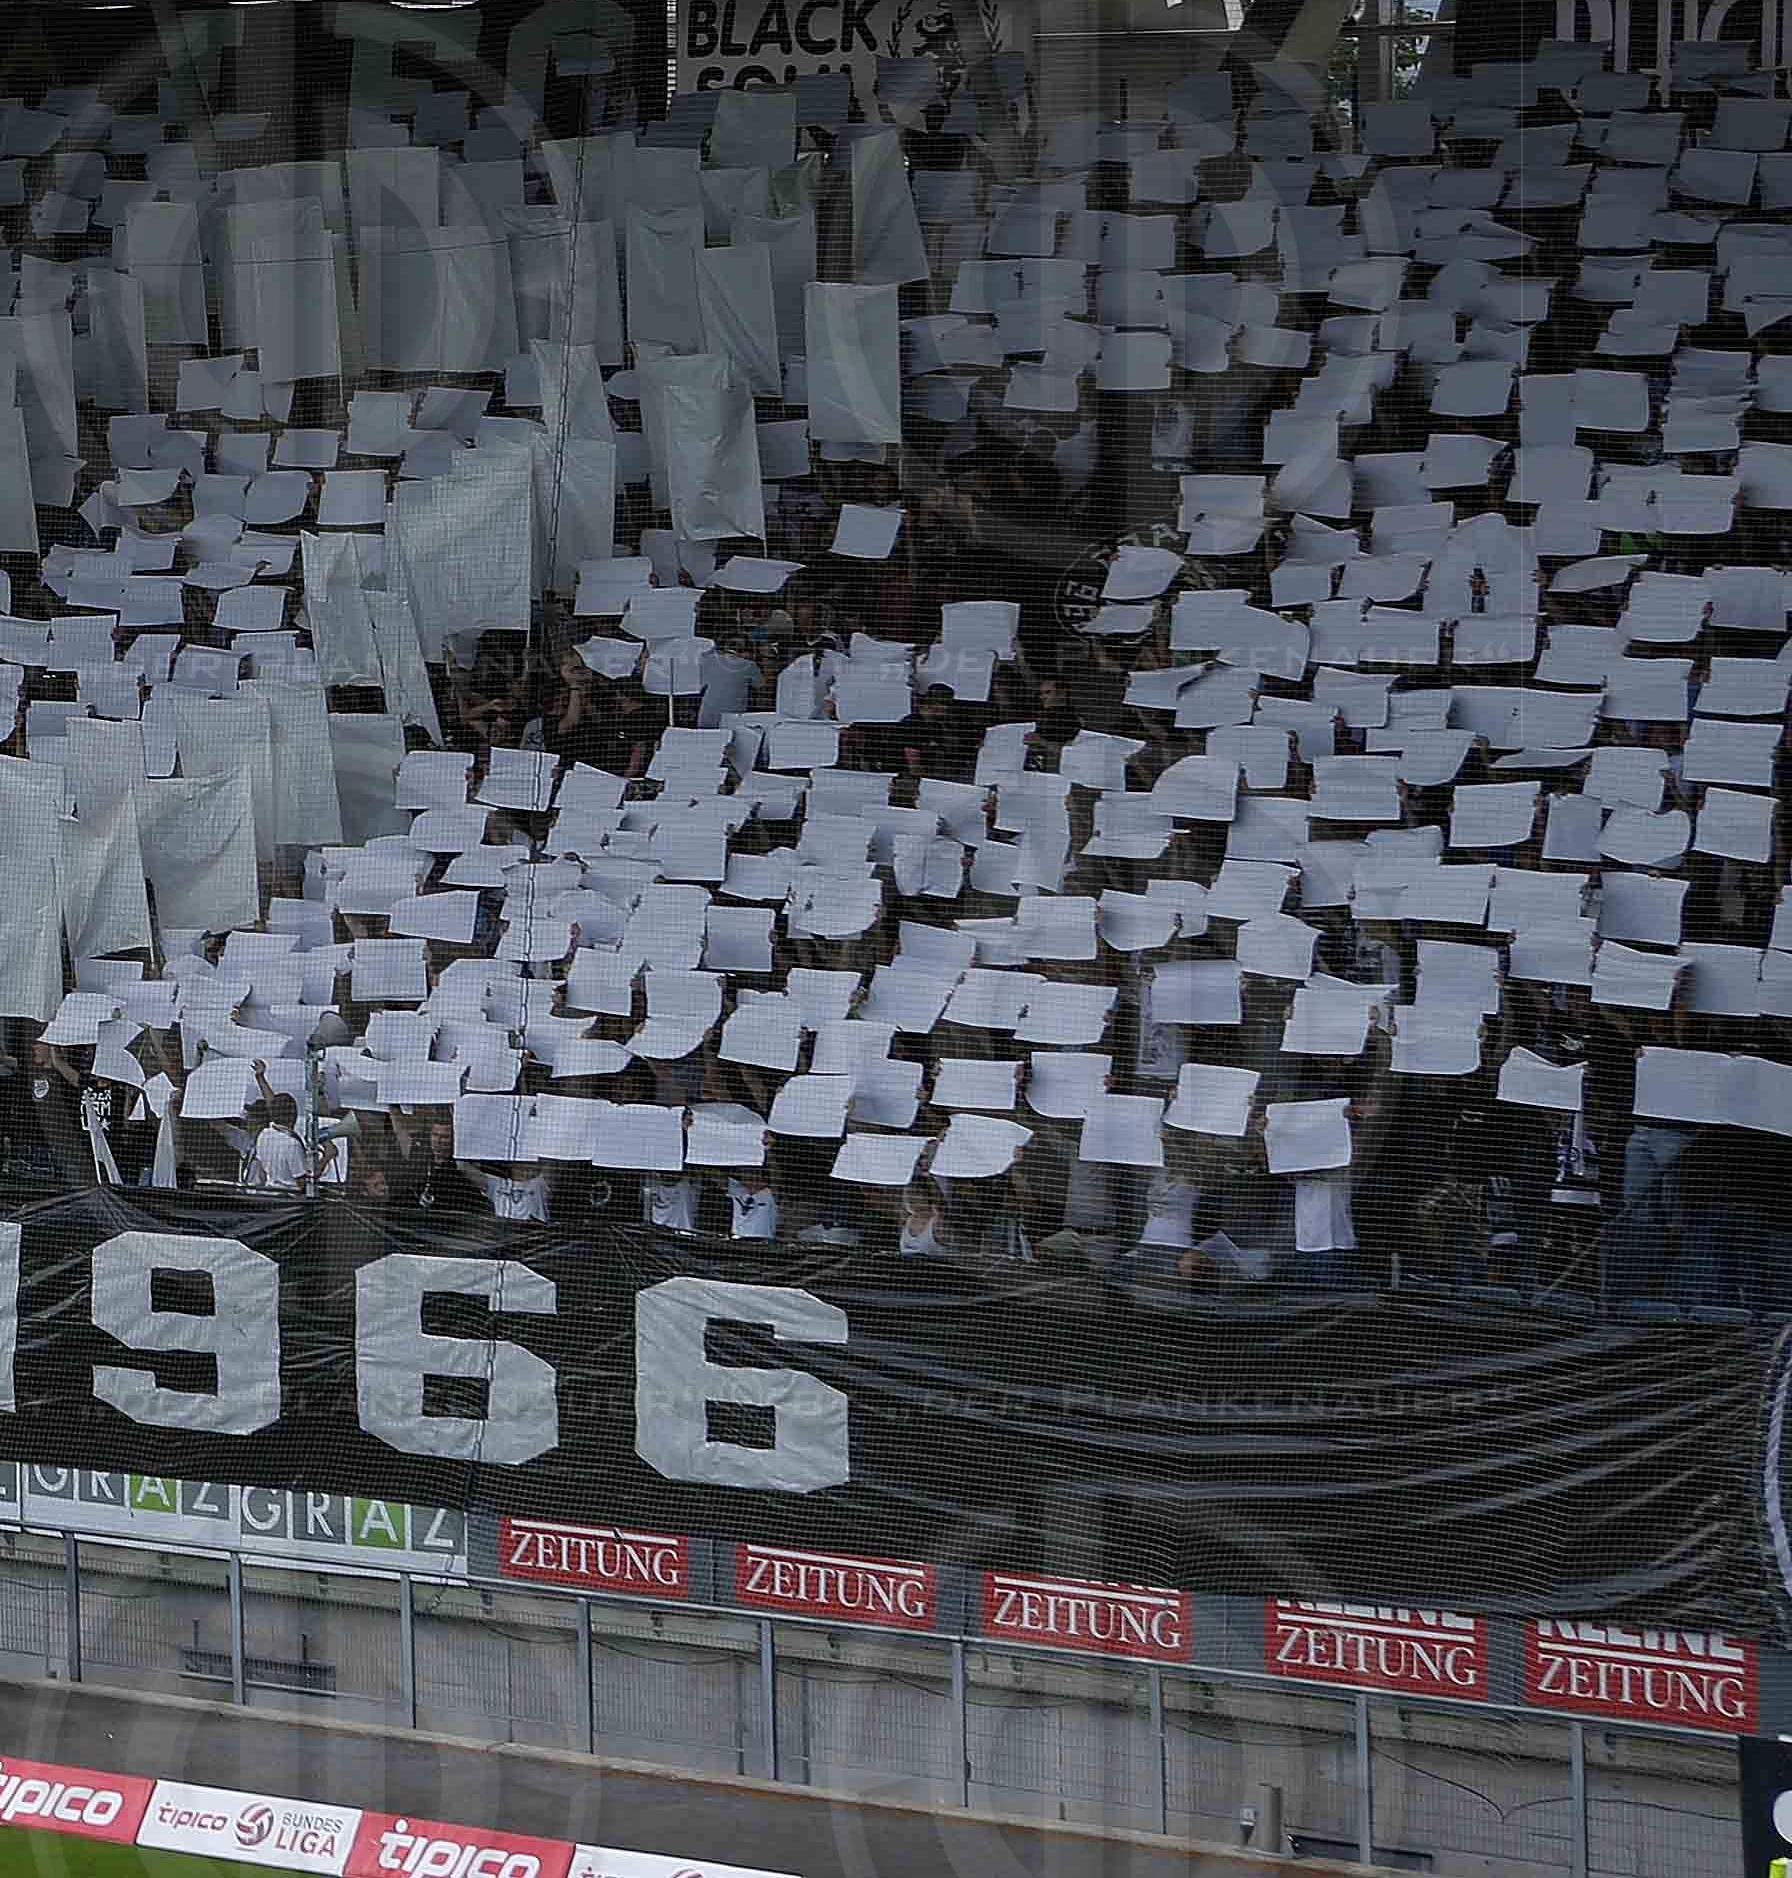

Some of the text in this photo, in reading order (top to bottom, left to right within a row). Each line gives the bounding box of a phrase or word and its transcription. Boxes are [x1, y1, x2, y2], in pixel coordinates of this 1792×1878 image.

[243, 1486, 453, 1550] GRAZ
[510, 1531, 680, 1585] ZEITUNG
[746, 1555, 926, 1617] ZEITUNG
[992, 1587, 1181, 1648] ZEITUNG
[1276, 1624, 1477, 1686] ZEITUNG
[1537, 1653, 1746, 1719] ZEITUNG
[157, 1801, 229, 1833] tipico
[273, 1826, 337, 1860] LIGA
[281, 1810, 344, 1834] BUNDES
